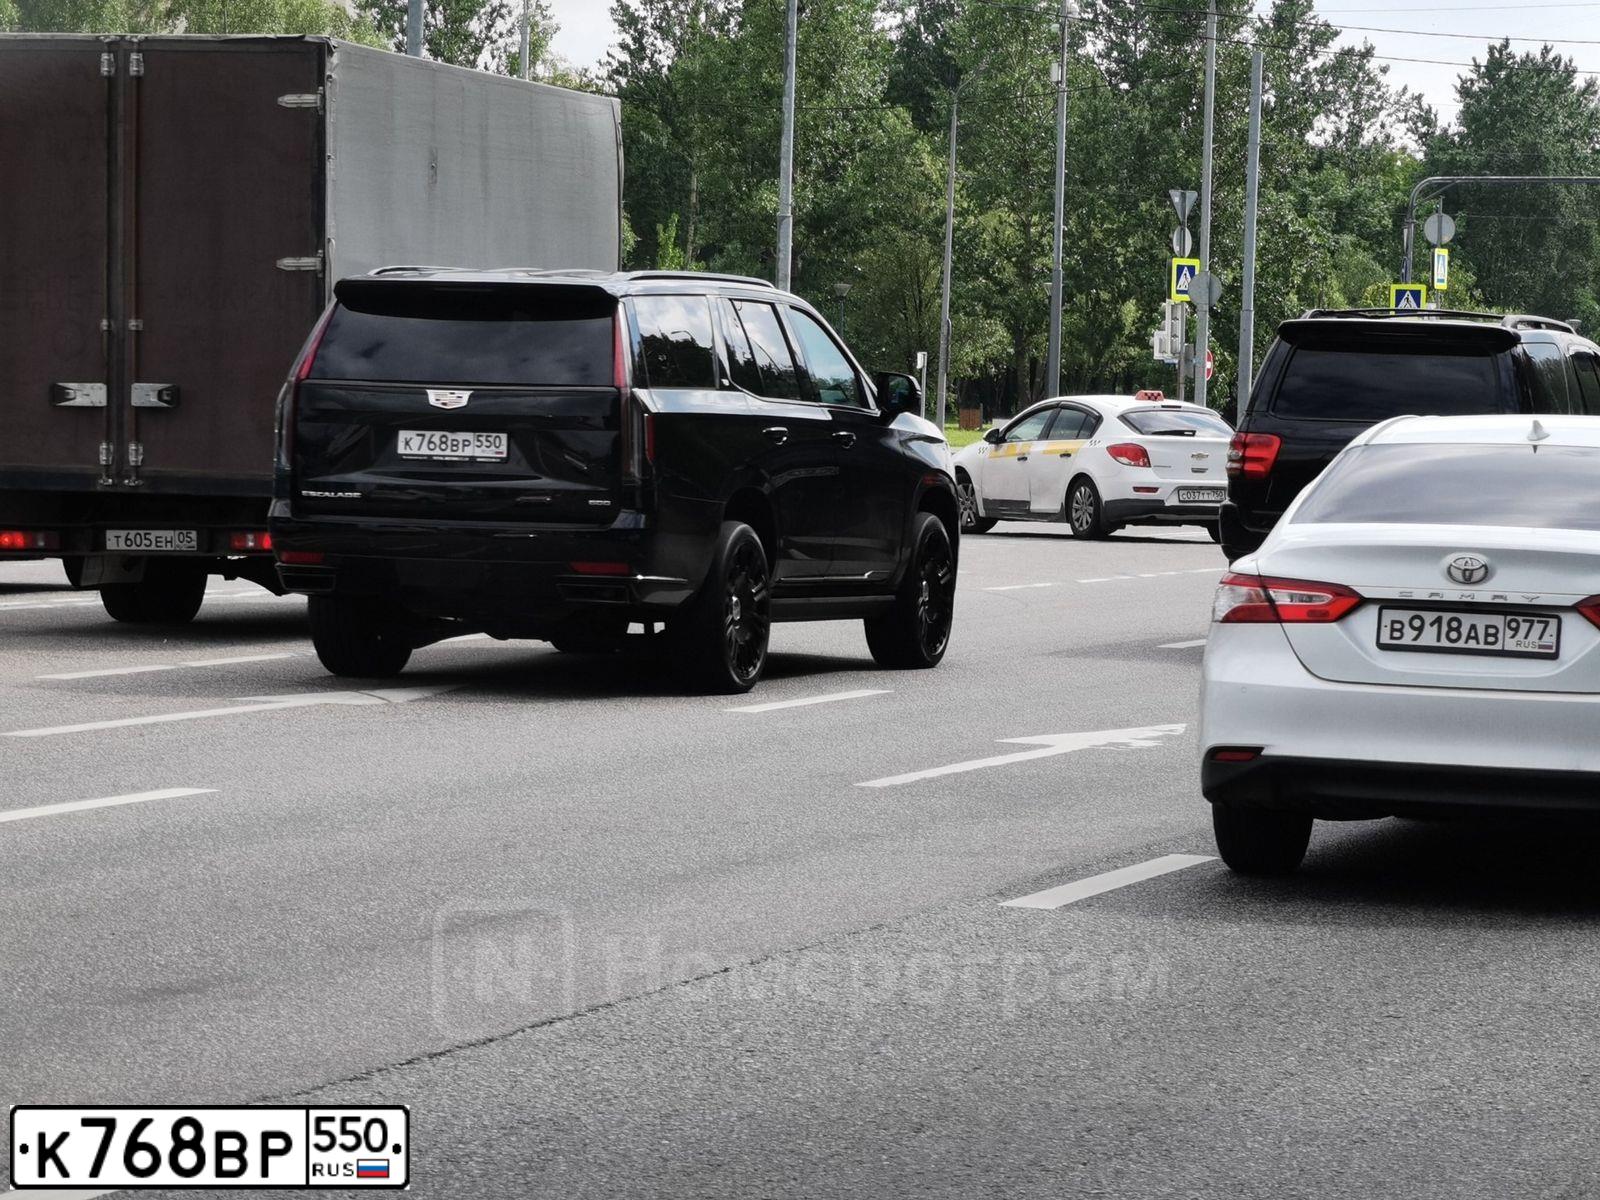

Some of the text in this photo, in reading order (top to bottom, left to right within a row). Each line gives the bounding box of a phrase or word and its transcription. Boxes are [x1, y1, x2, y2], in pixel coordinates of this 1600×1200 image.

[475, 434, 502, 449] 550
[177, 531, 194, 544] 05
[1506, 617, 1551, 641] 977
[1515, 640, 1538, 650] RUS
